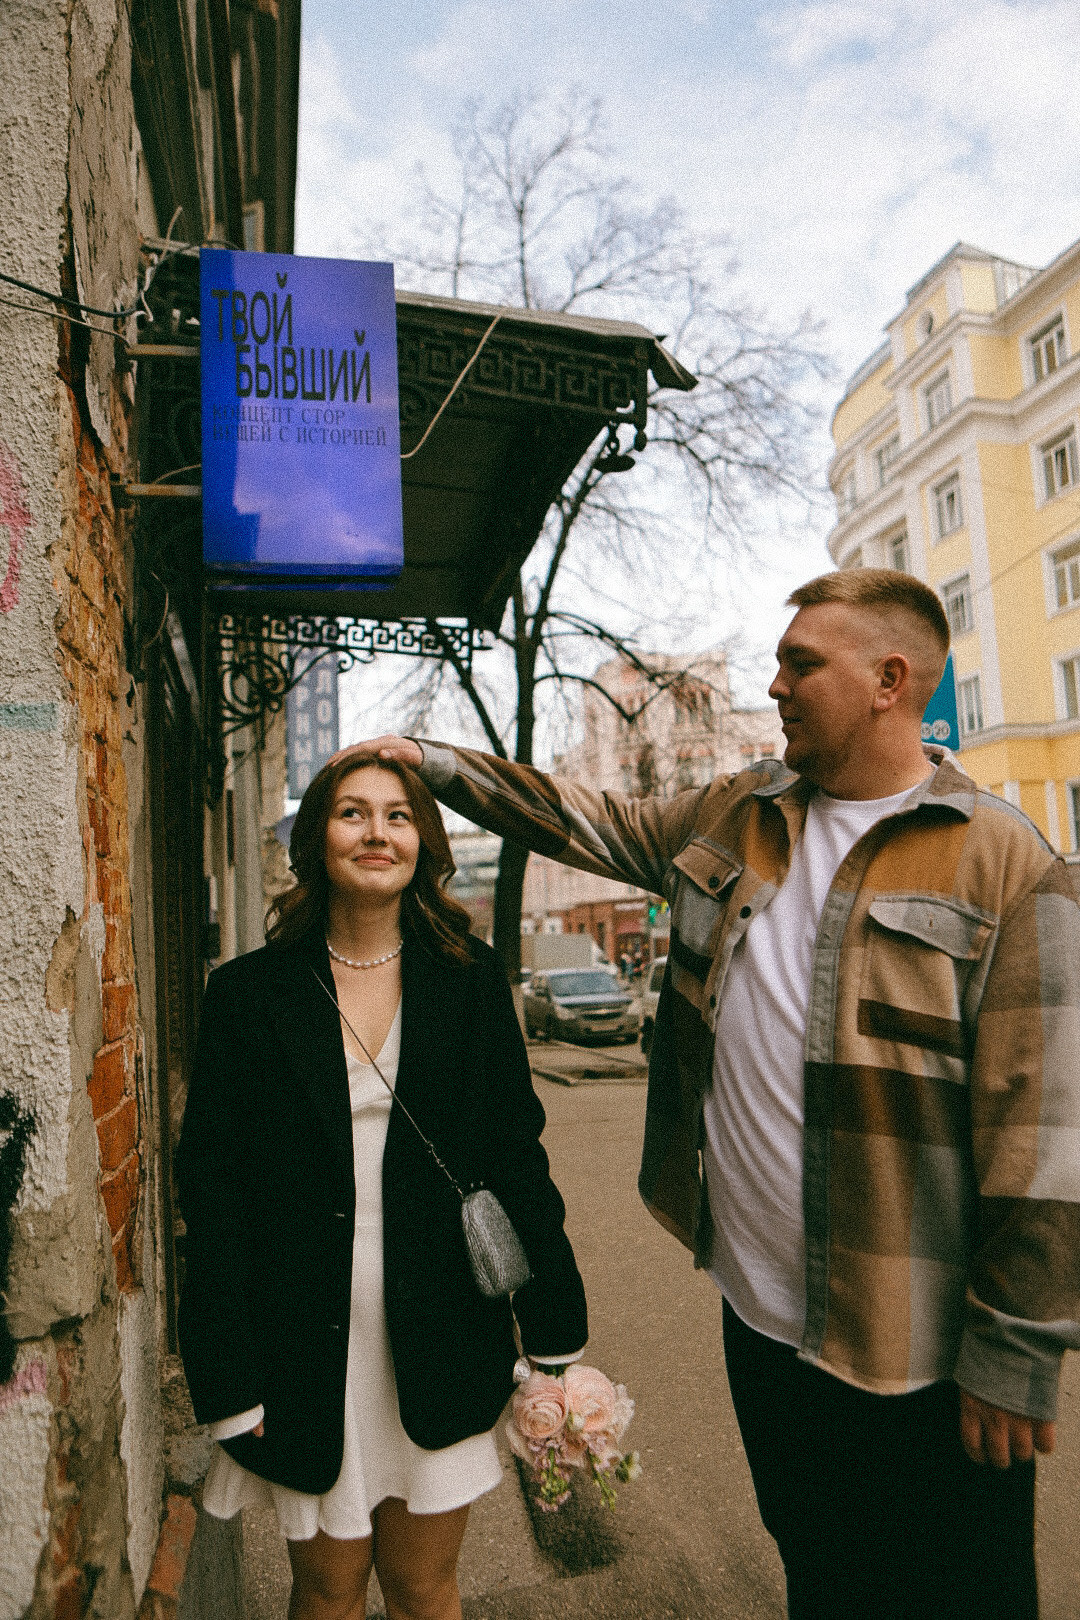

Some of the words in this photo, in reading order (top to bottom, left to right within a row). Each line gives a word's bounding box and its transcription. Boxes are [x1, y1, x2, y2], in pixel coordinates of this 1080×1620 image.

[211, 272, 293, 345] ТВОЙ
[235, 329, 372, 404] БЫВШИЙ
[212, 403, 295, 424] КОНЦЕПТ
[301, 407, 346, 426] СТОР
[212, 422, 272, 443] ВЕЩЕЙ
[279, 426, 290, 443] С
[297, 426, 387, 446] ИСТОРИЕЙ
